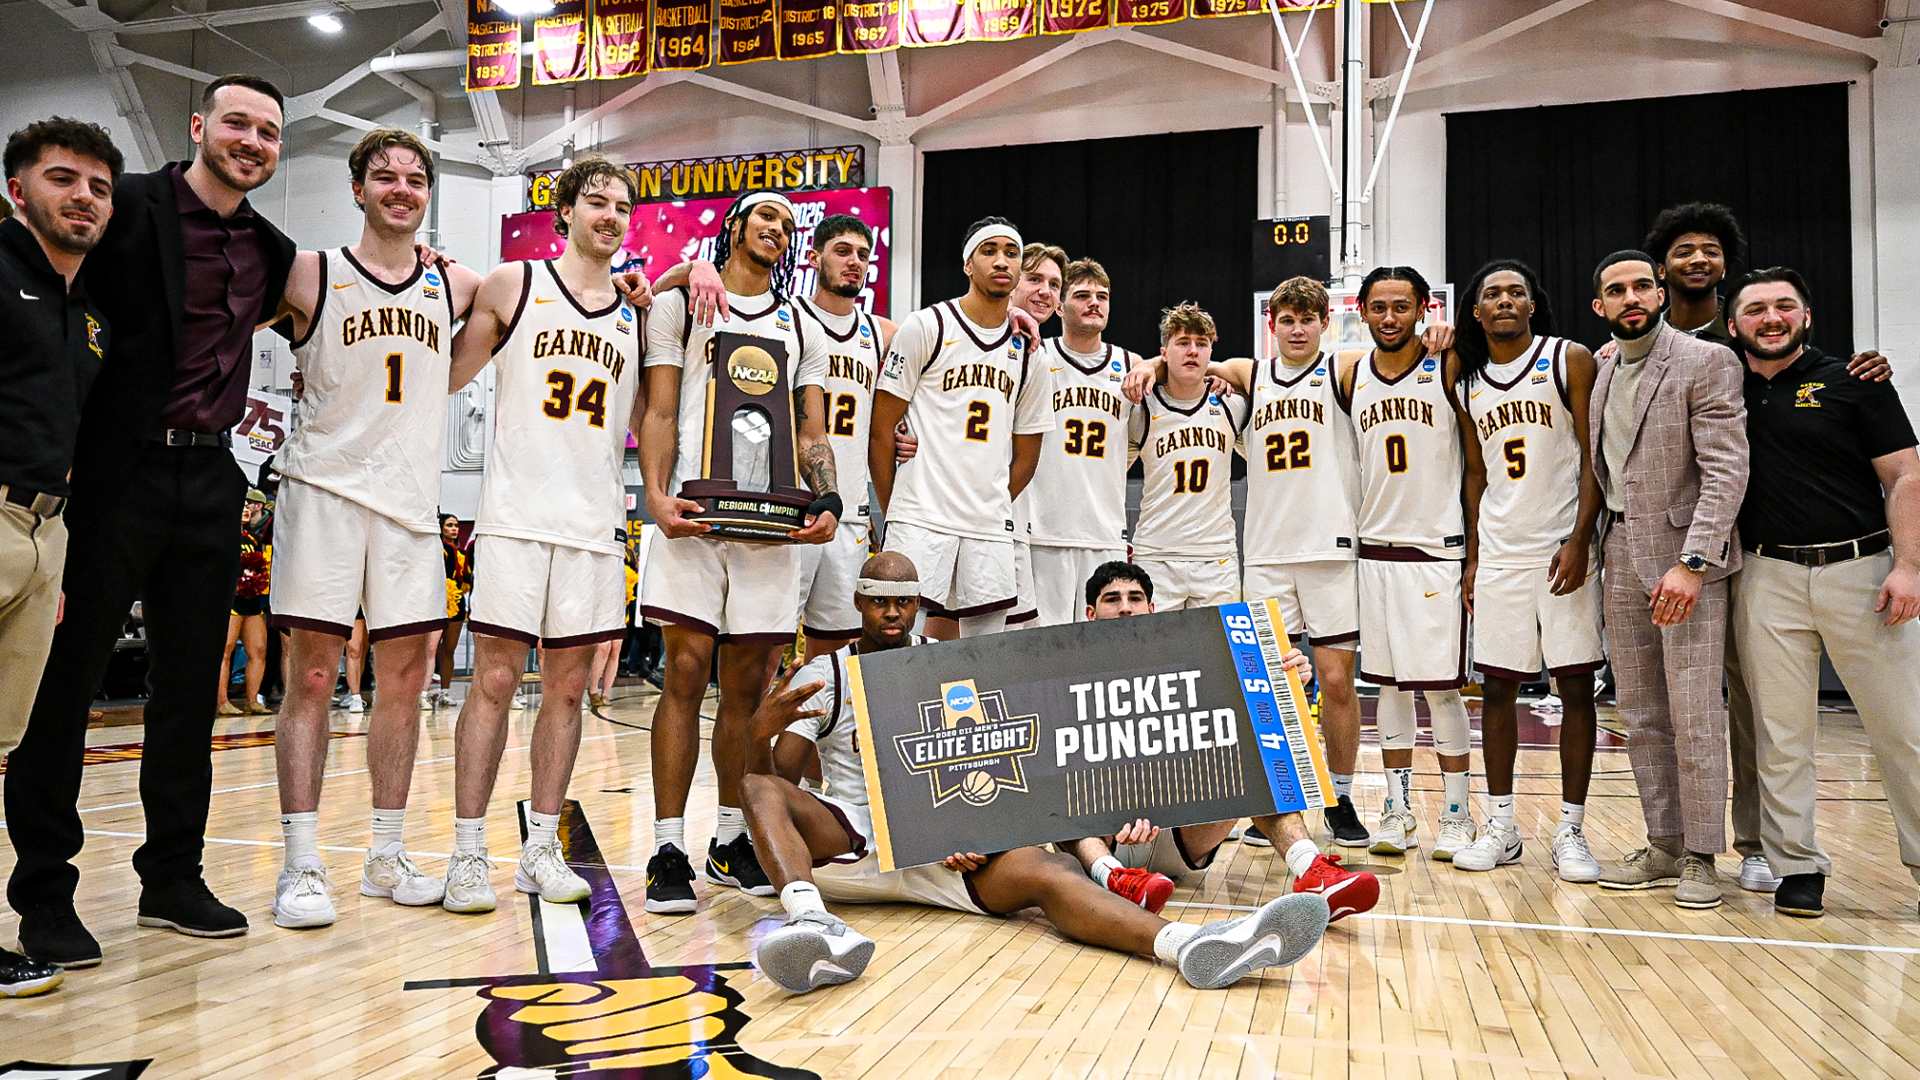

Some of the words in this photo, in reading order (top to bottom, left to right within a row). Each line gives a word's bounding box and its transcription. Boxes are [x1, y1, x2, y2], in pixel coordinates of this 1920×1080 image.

[656, 4, 709, 27] BASKETBALL
[783, 9, 821, 23] DISTRICT
[823, 6, 835, 19] 18
[844, 3, 885, 18] DISTRICT
[1050, 0, 1102, 18] 1972
[1131, 2, 1169, 18] 1975
[720, 16, 760, 30] DISTRICT
[855, 26, 888, 41] 1967
[983, 16, 1019, 32] 1969
[660, 35, 705, 57] 1964
[733, 35, 760, 52] 1964
[792, 31, 825, 46] 1965
[600, 41, 640, 66] 1962
[476, 65, 505, 79] 1954
[671, 152, 856, 196] UNIVERSITY
[1274, 223, 1309, 245] 0.0
[342, 307, 439, 355] GANNON
[533, 328, 625, 385] GANNON
[385, 352, 403, 404] 1
[732, 365, 777, 385] NCAA
[942, 363, 1015, 405] GANNON
[542, 368, 608, 430] 34
[1052, 386, 1122, 421] GANNON
[965, 399, 992, 443] 2
[1254, 398, 1324, 431] GANNON
[1359, 397, 1435, 434] GANNON
[1479, 400, 1553, 441] GANNON
[249, 437, 274, 451] PSAC
[1064, 417, 1107, 460] 32
[1156, 426, 1226, 459] GANNON
[1265, 430, 1311, 472] 22
[1385, 434, 1408, 474] 0
[1503, 437, 1526, 480] 5
[1173, 457, 1210, 495] 10
[718, 500, 758, 512] REGIONAL
[1225, 615, 1258, 645] 26
[1240, 650, 1260, 674] SEAT
[1069, 670, 1201, 721] TICKET
[1243, 678, 1271, 693] 5
[949, 696, 976, 706] NCAA
[1254, 701, 1275, 724] ROW
[974, 723, 999, 733] MEN'S
[1055, 708, 1238, 768] PUNCHED
[915, 736, 968, 763] ELITE
[971, 726, 1028, 754] EIGHT
[1260, 732, 1285, 750] 4
[948, 757, 1000, 772] PITTSBURGH
[1272, 759, 1298, 804] SECTION
